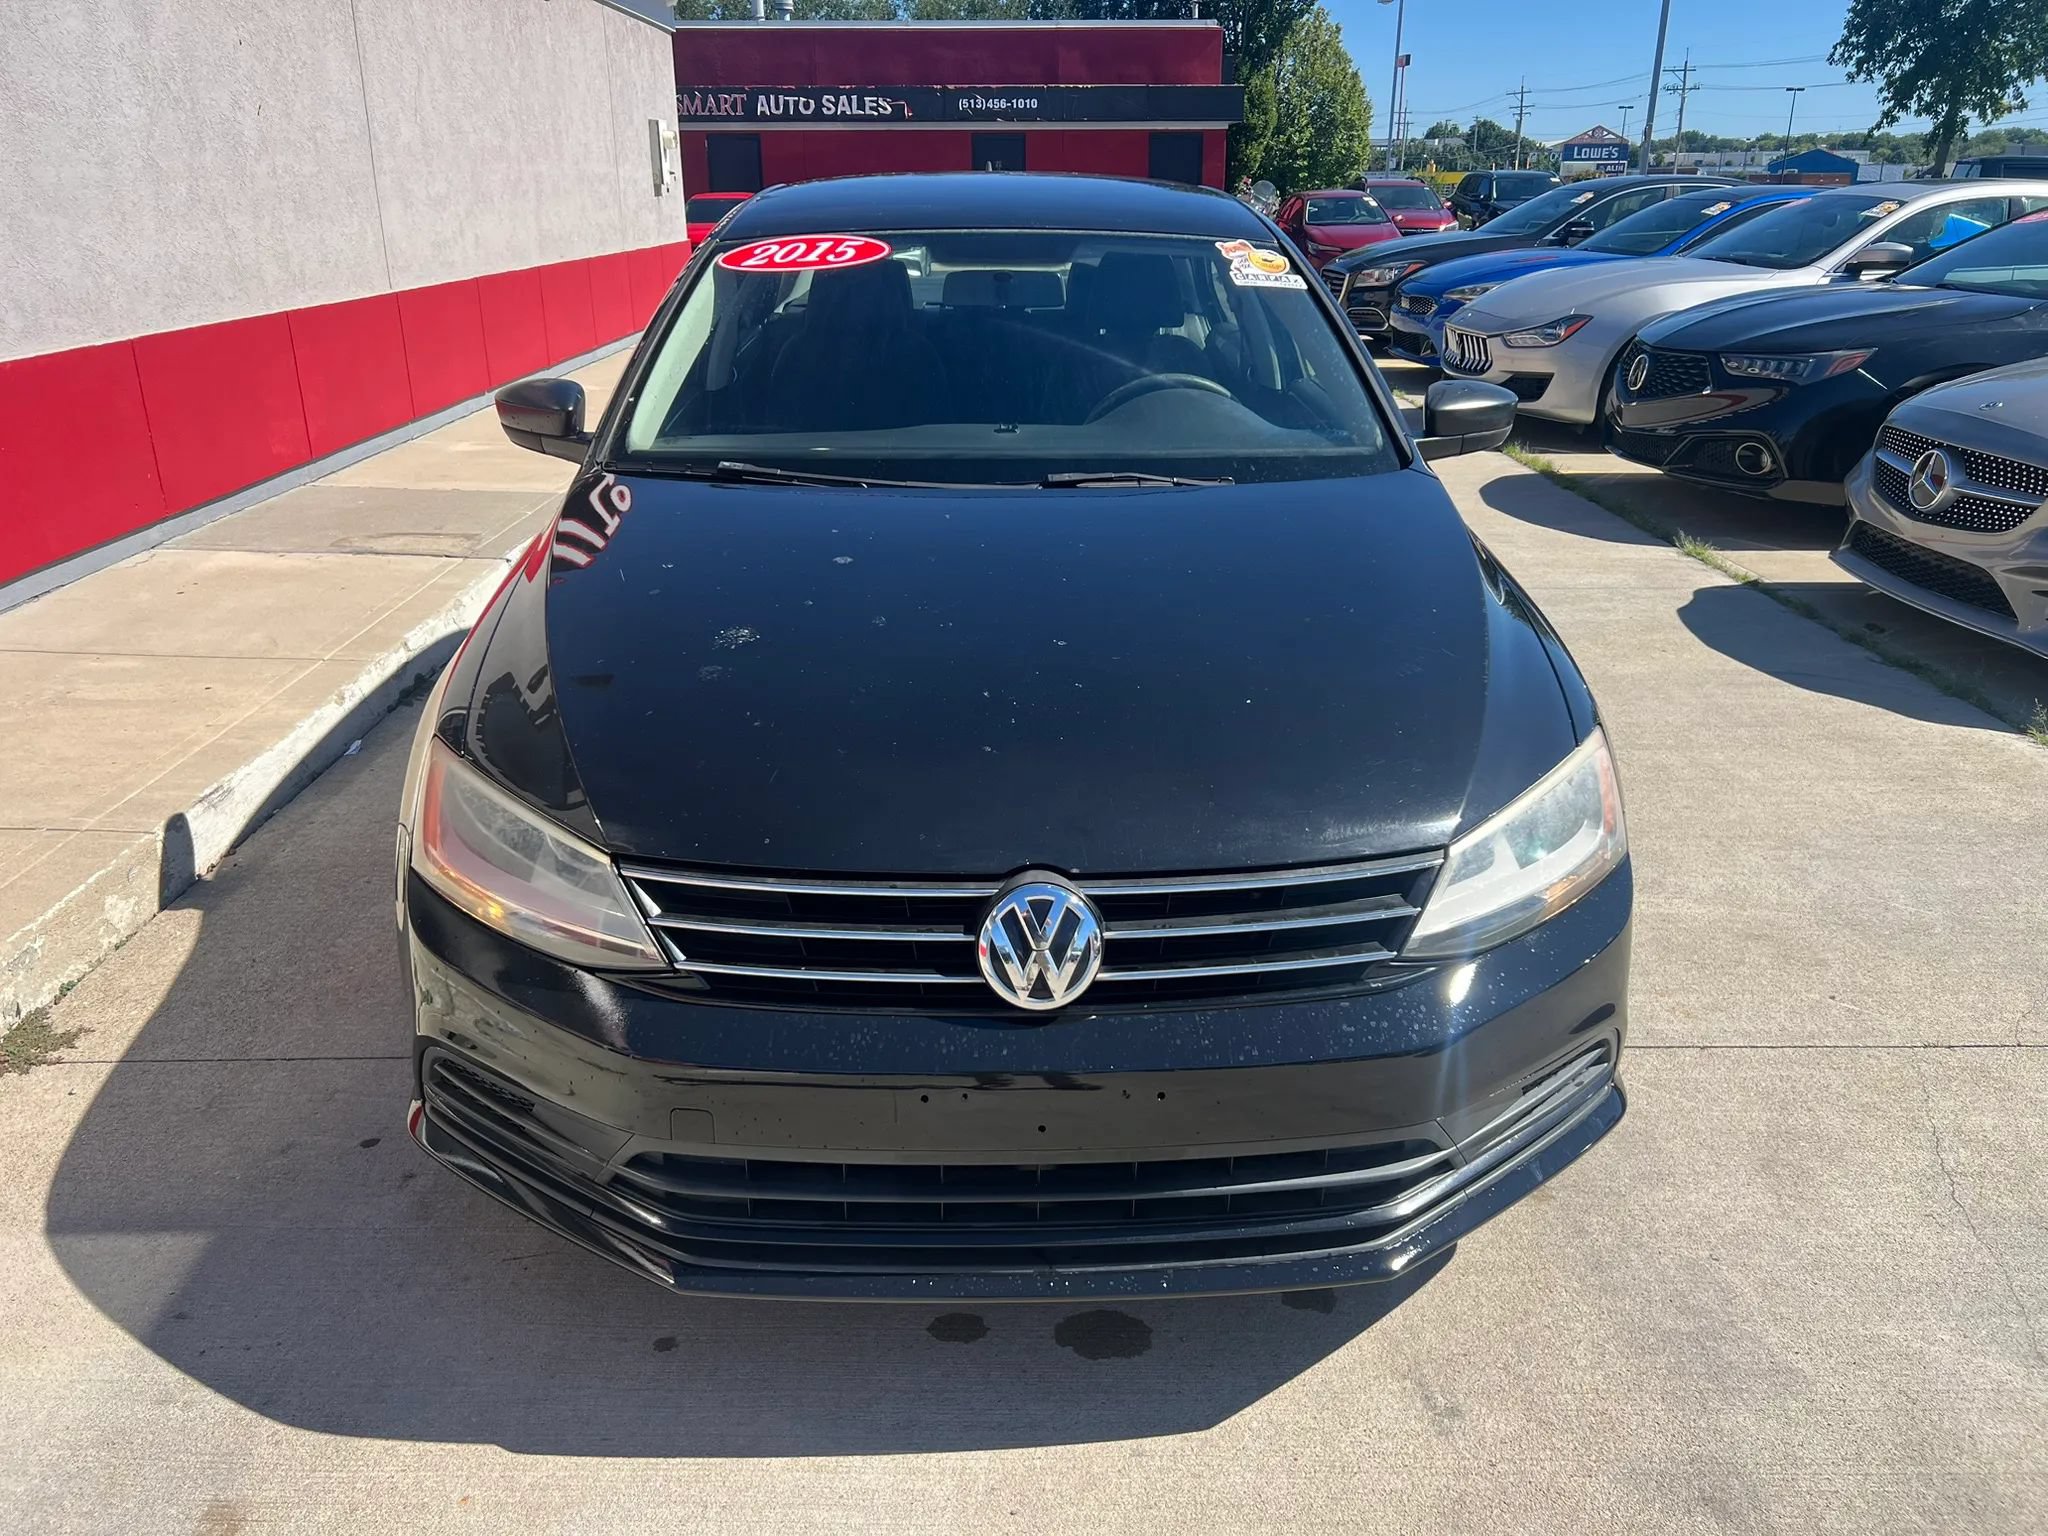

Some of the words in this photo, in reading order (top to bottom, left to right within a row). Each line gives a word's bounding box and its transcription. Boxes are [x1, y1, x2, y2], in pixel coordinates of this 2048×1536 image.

[757, 94, 815, 115] AUTO
[821, 94, 892, 115] SALES
[958, 98, 1038, 110] (513)456-1010
[1573, 146, 1619, 159] LOWE'S
[740, 240, 864, 267] 2015
